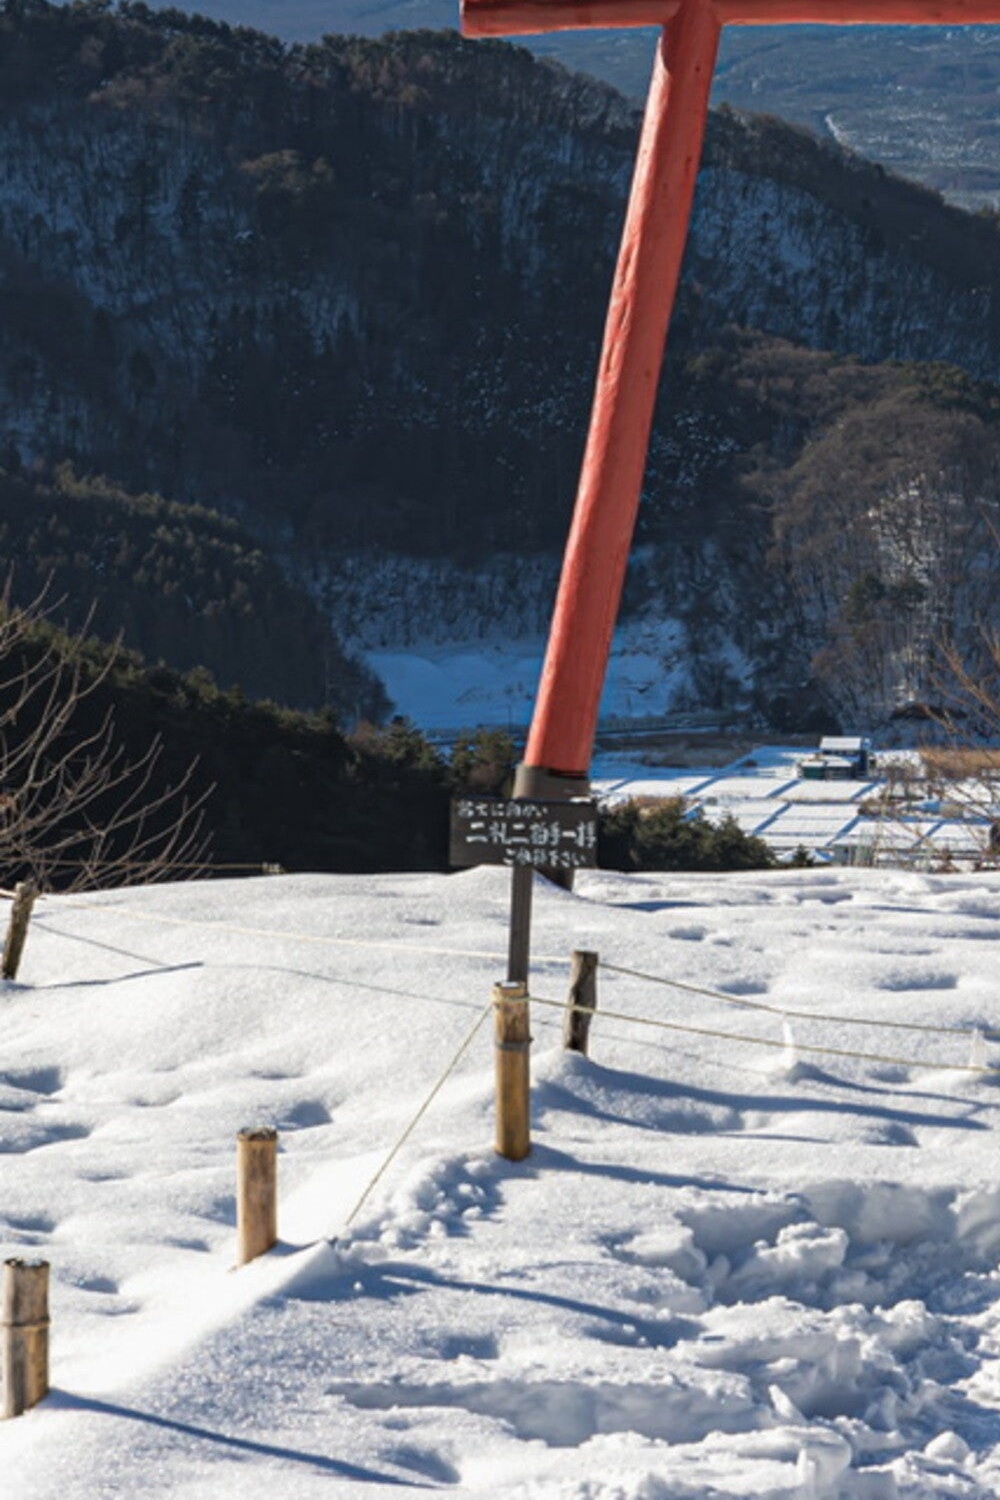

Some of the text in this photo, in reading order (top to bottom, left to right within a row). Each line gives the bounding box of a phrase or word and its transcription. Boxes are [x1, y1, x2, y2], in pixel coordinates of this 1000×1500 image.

[466, 821, 597, 848] 二礼二拍手一拝
